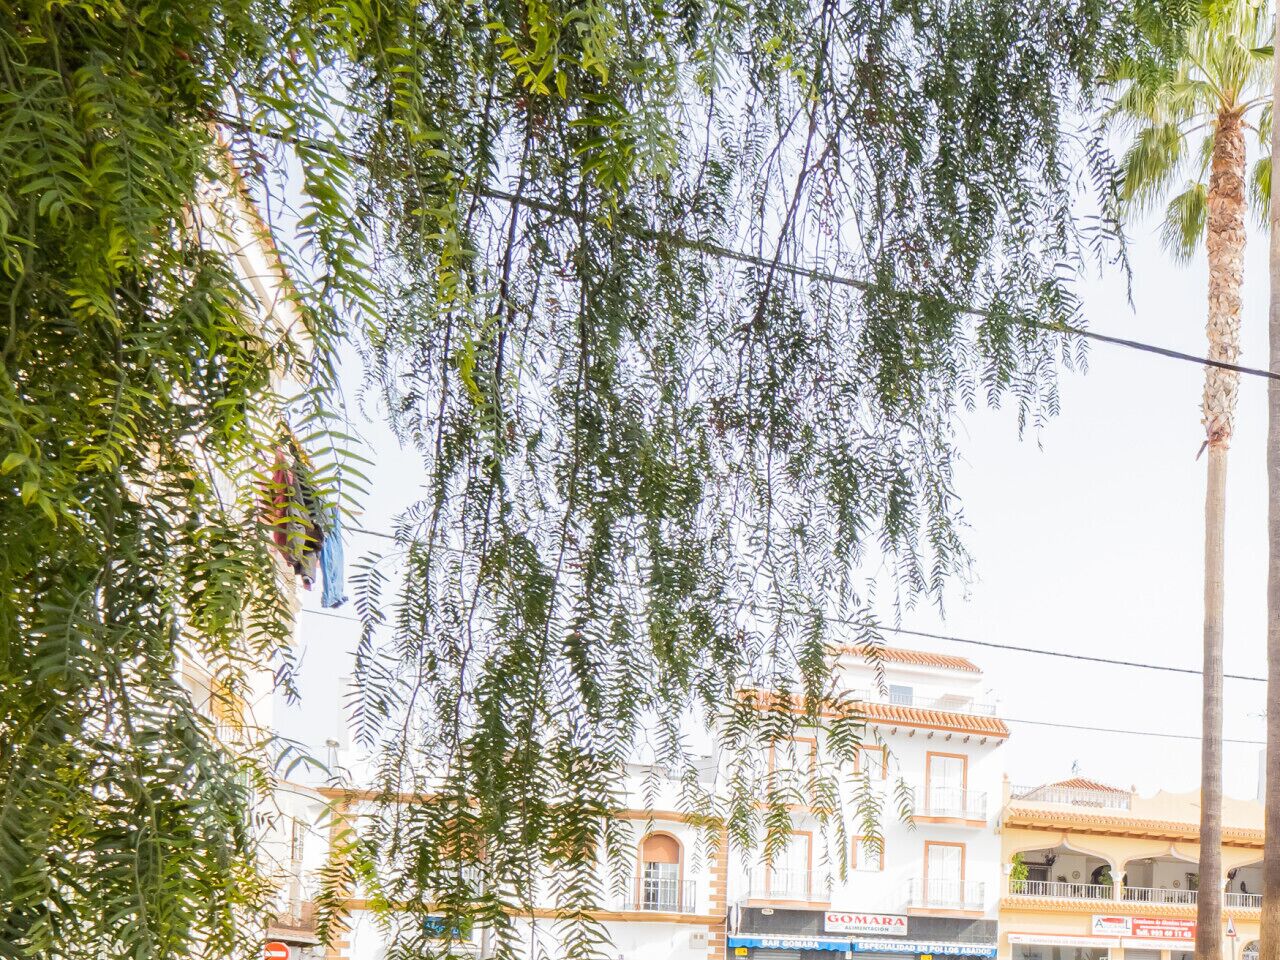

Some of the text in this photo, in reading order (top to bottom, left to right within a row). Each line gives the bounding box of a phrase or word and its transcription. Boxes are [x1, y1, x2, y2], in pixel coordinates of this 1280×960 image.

[827, 914, 905, 926] GOMARA
[762, 939, 819, 948] BAR GOMARA
[858, 943, 915, 951] ESPECIALIDAD
